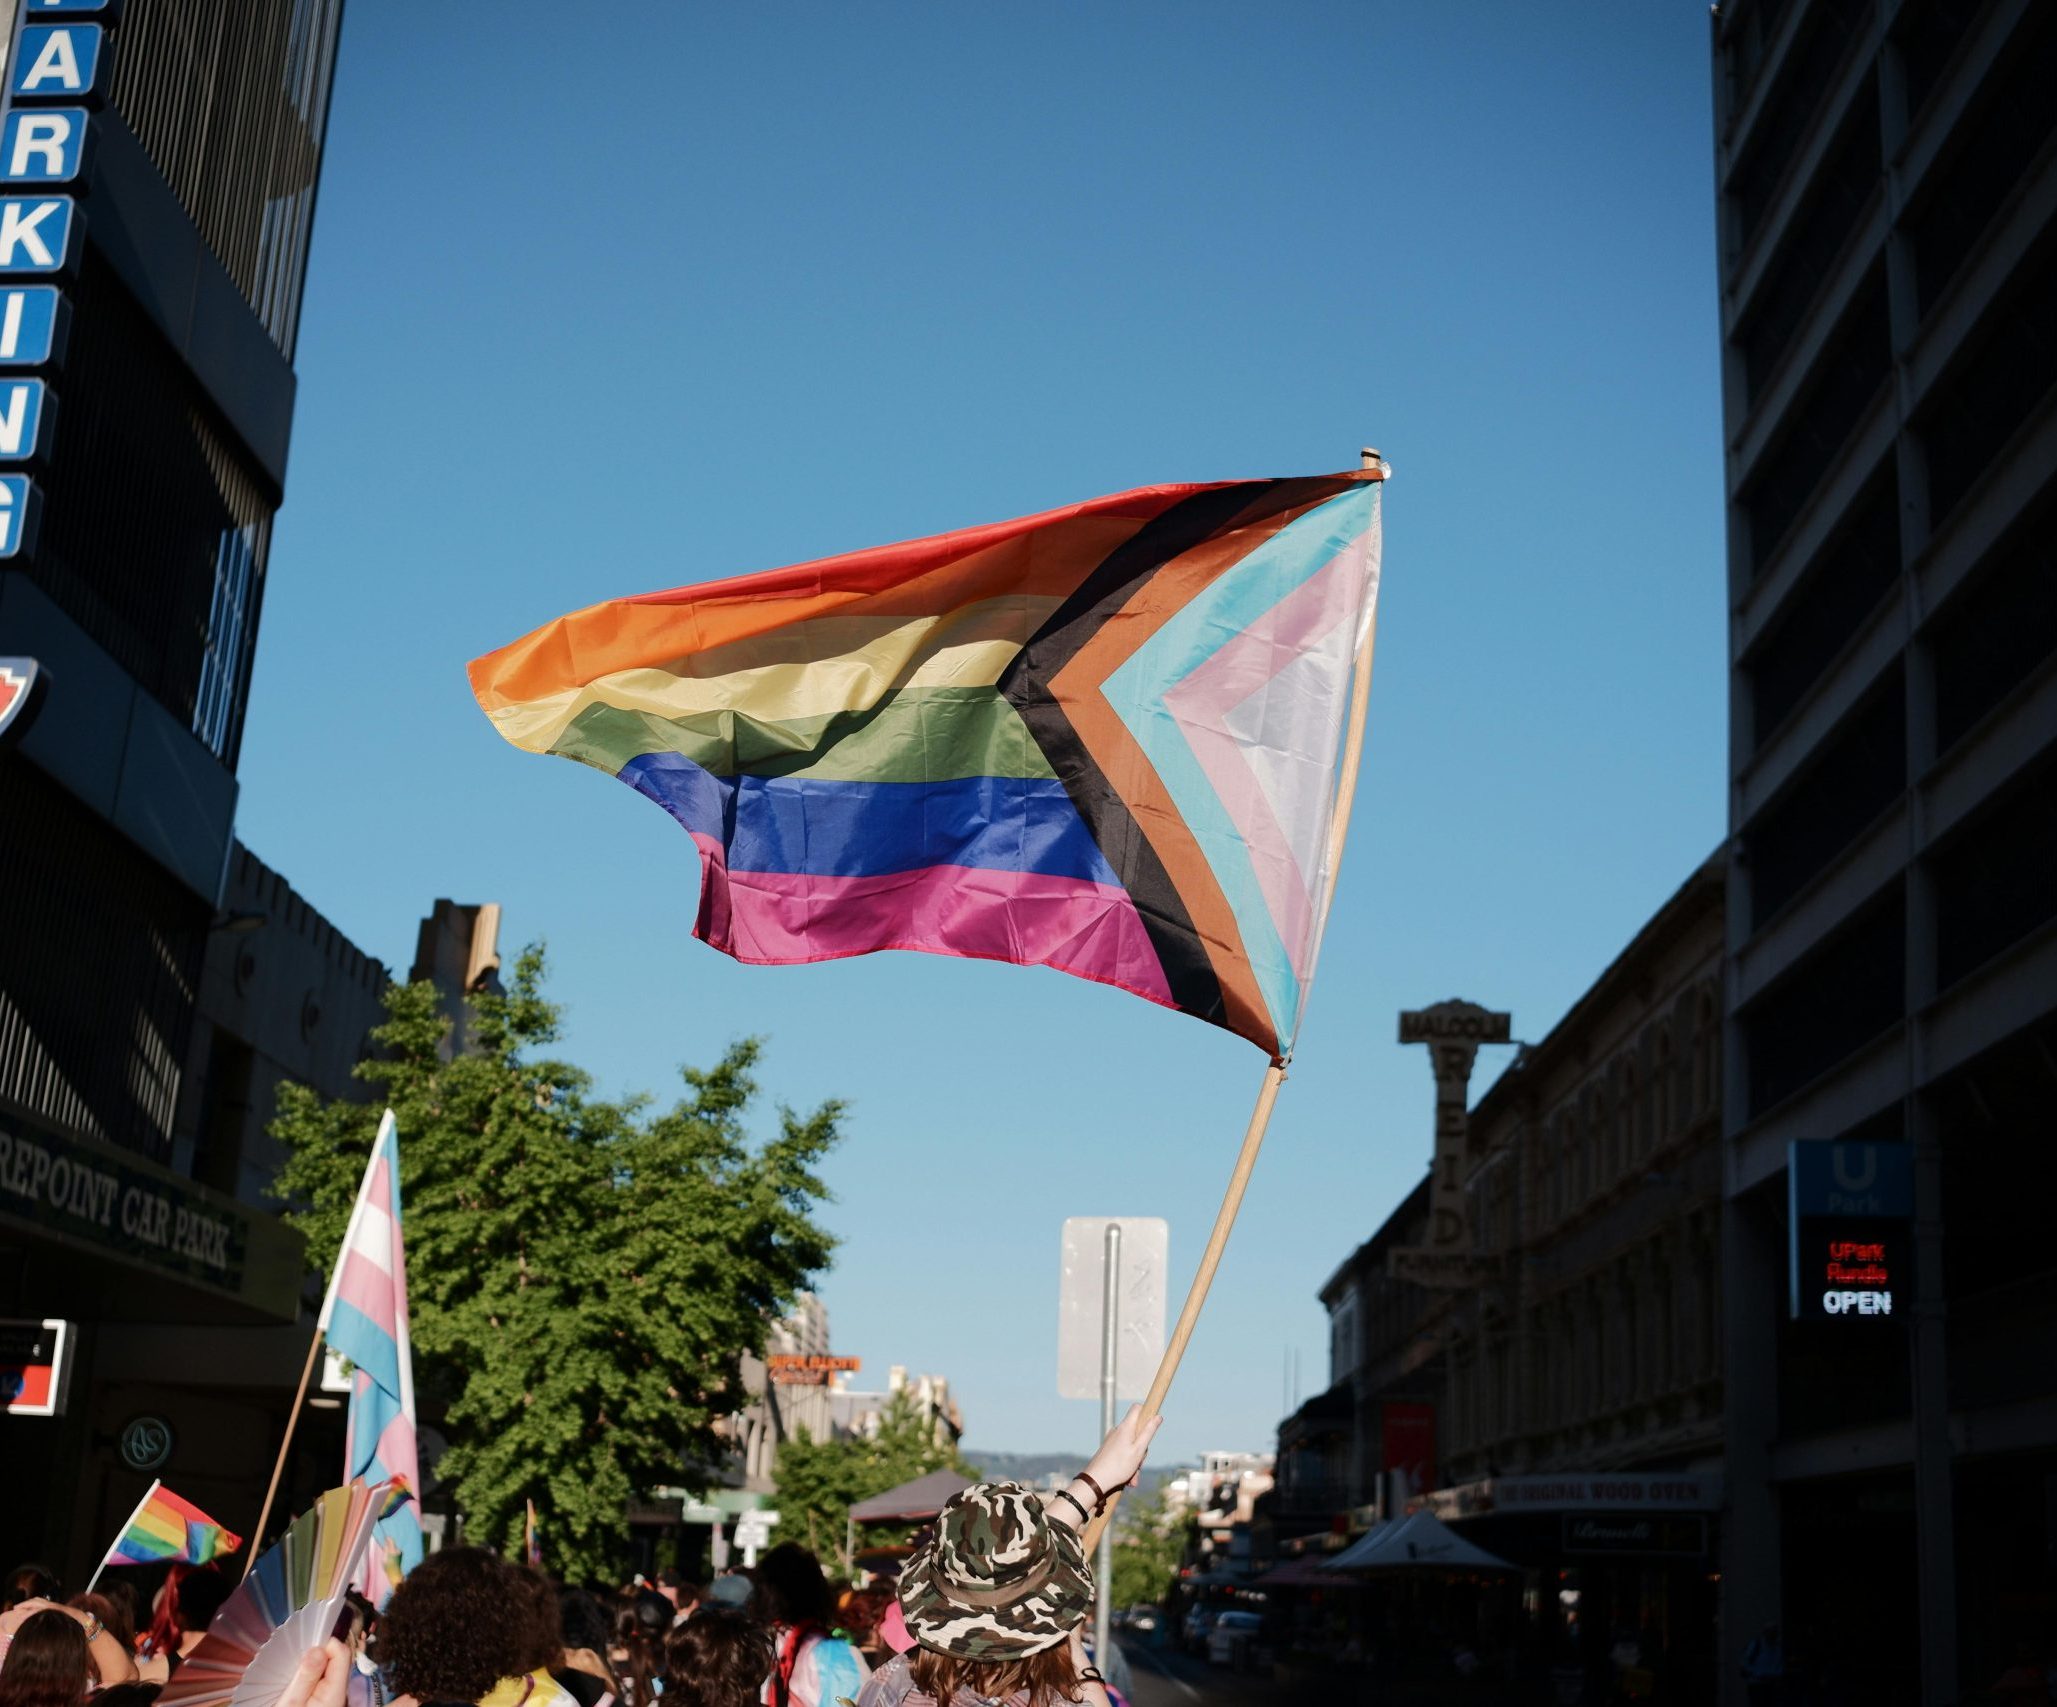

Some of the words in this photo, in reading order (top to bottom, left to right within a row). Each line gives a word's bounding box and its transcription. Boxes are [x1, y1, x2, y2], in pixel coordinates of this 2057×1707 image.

[0, 0, 82, 549] ARKIN
[1401, 1014, 1509, 1039] MALCOLM
[1434, 1046, 1467, 1244] REID
[1832, 1144, 1877, 1192] U
[1827, 1192, 1880, 1214] Park
[121, 1186, 170, 1249] CAR
[171, 1206, 231, 1271] PARK
[1823, 1290, 1892, 1315] OPEN
[1590, 1481, 1643, 1501] WOOD
[1649, 1481, 1698, 1499] OVEN
